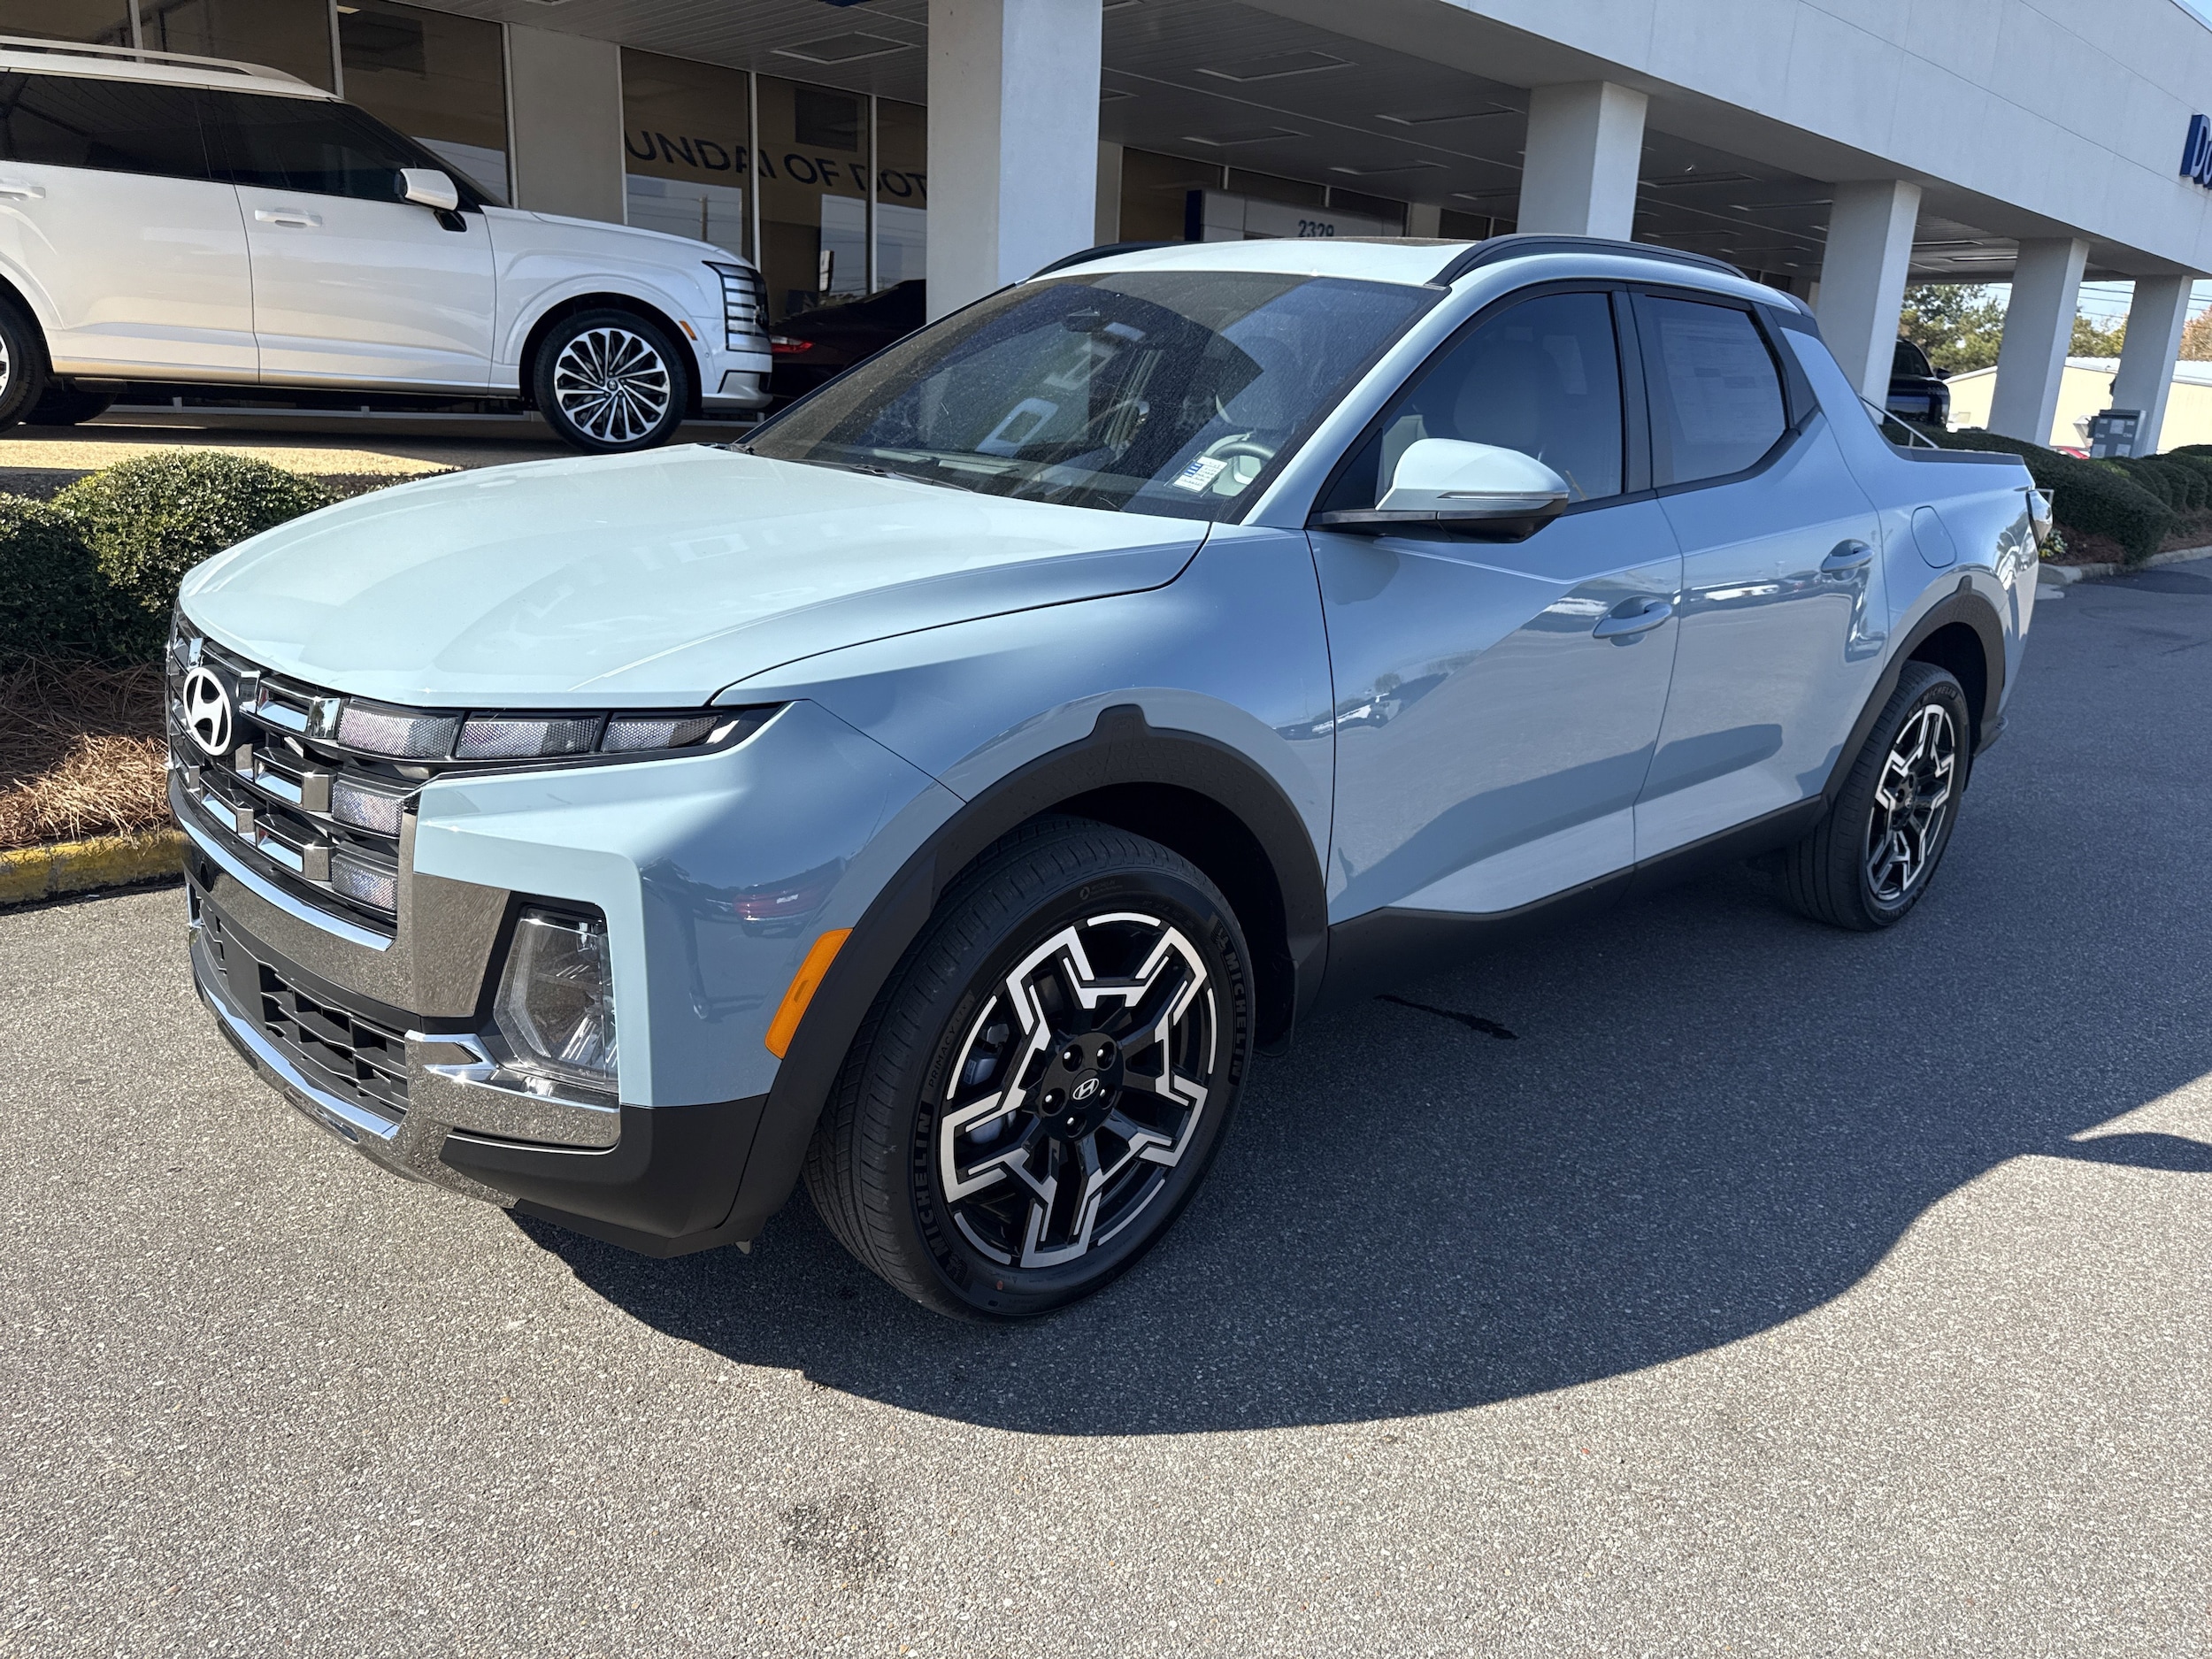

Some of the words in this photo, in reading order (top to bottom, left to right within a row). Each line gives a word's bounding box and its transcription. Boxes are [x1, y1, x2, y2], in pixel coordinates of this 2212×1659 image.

[784, 153, 841, 187] OF
[927, 1025, 956, 1088] PRIMACY
[1223, 951, 1248, 1079] MICHELIN
[913, 1112, 952, 1258] MICHELIN
